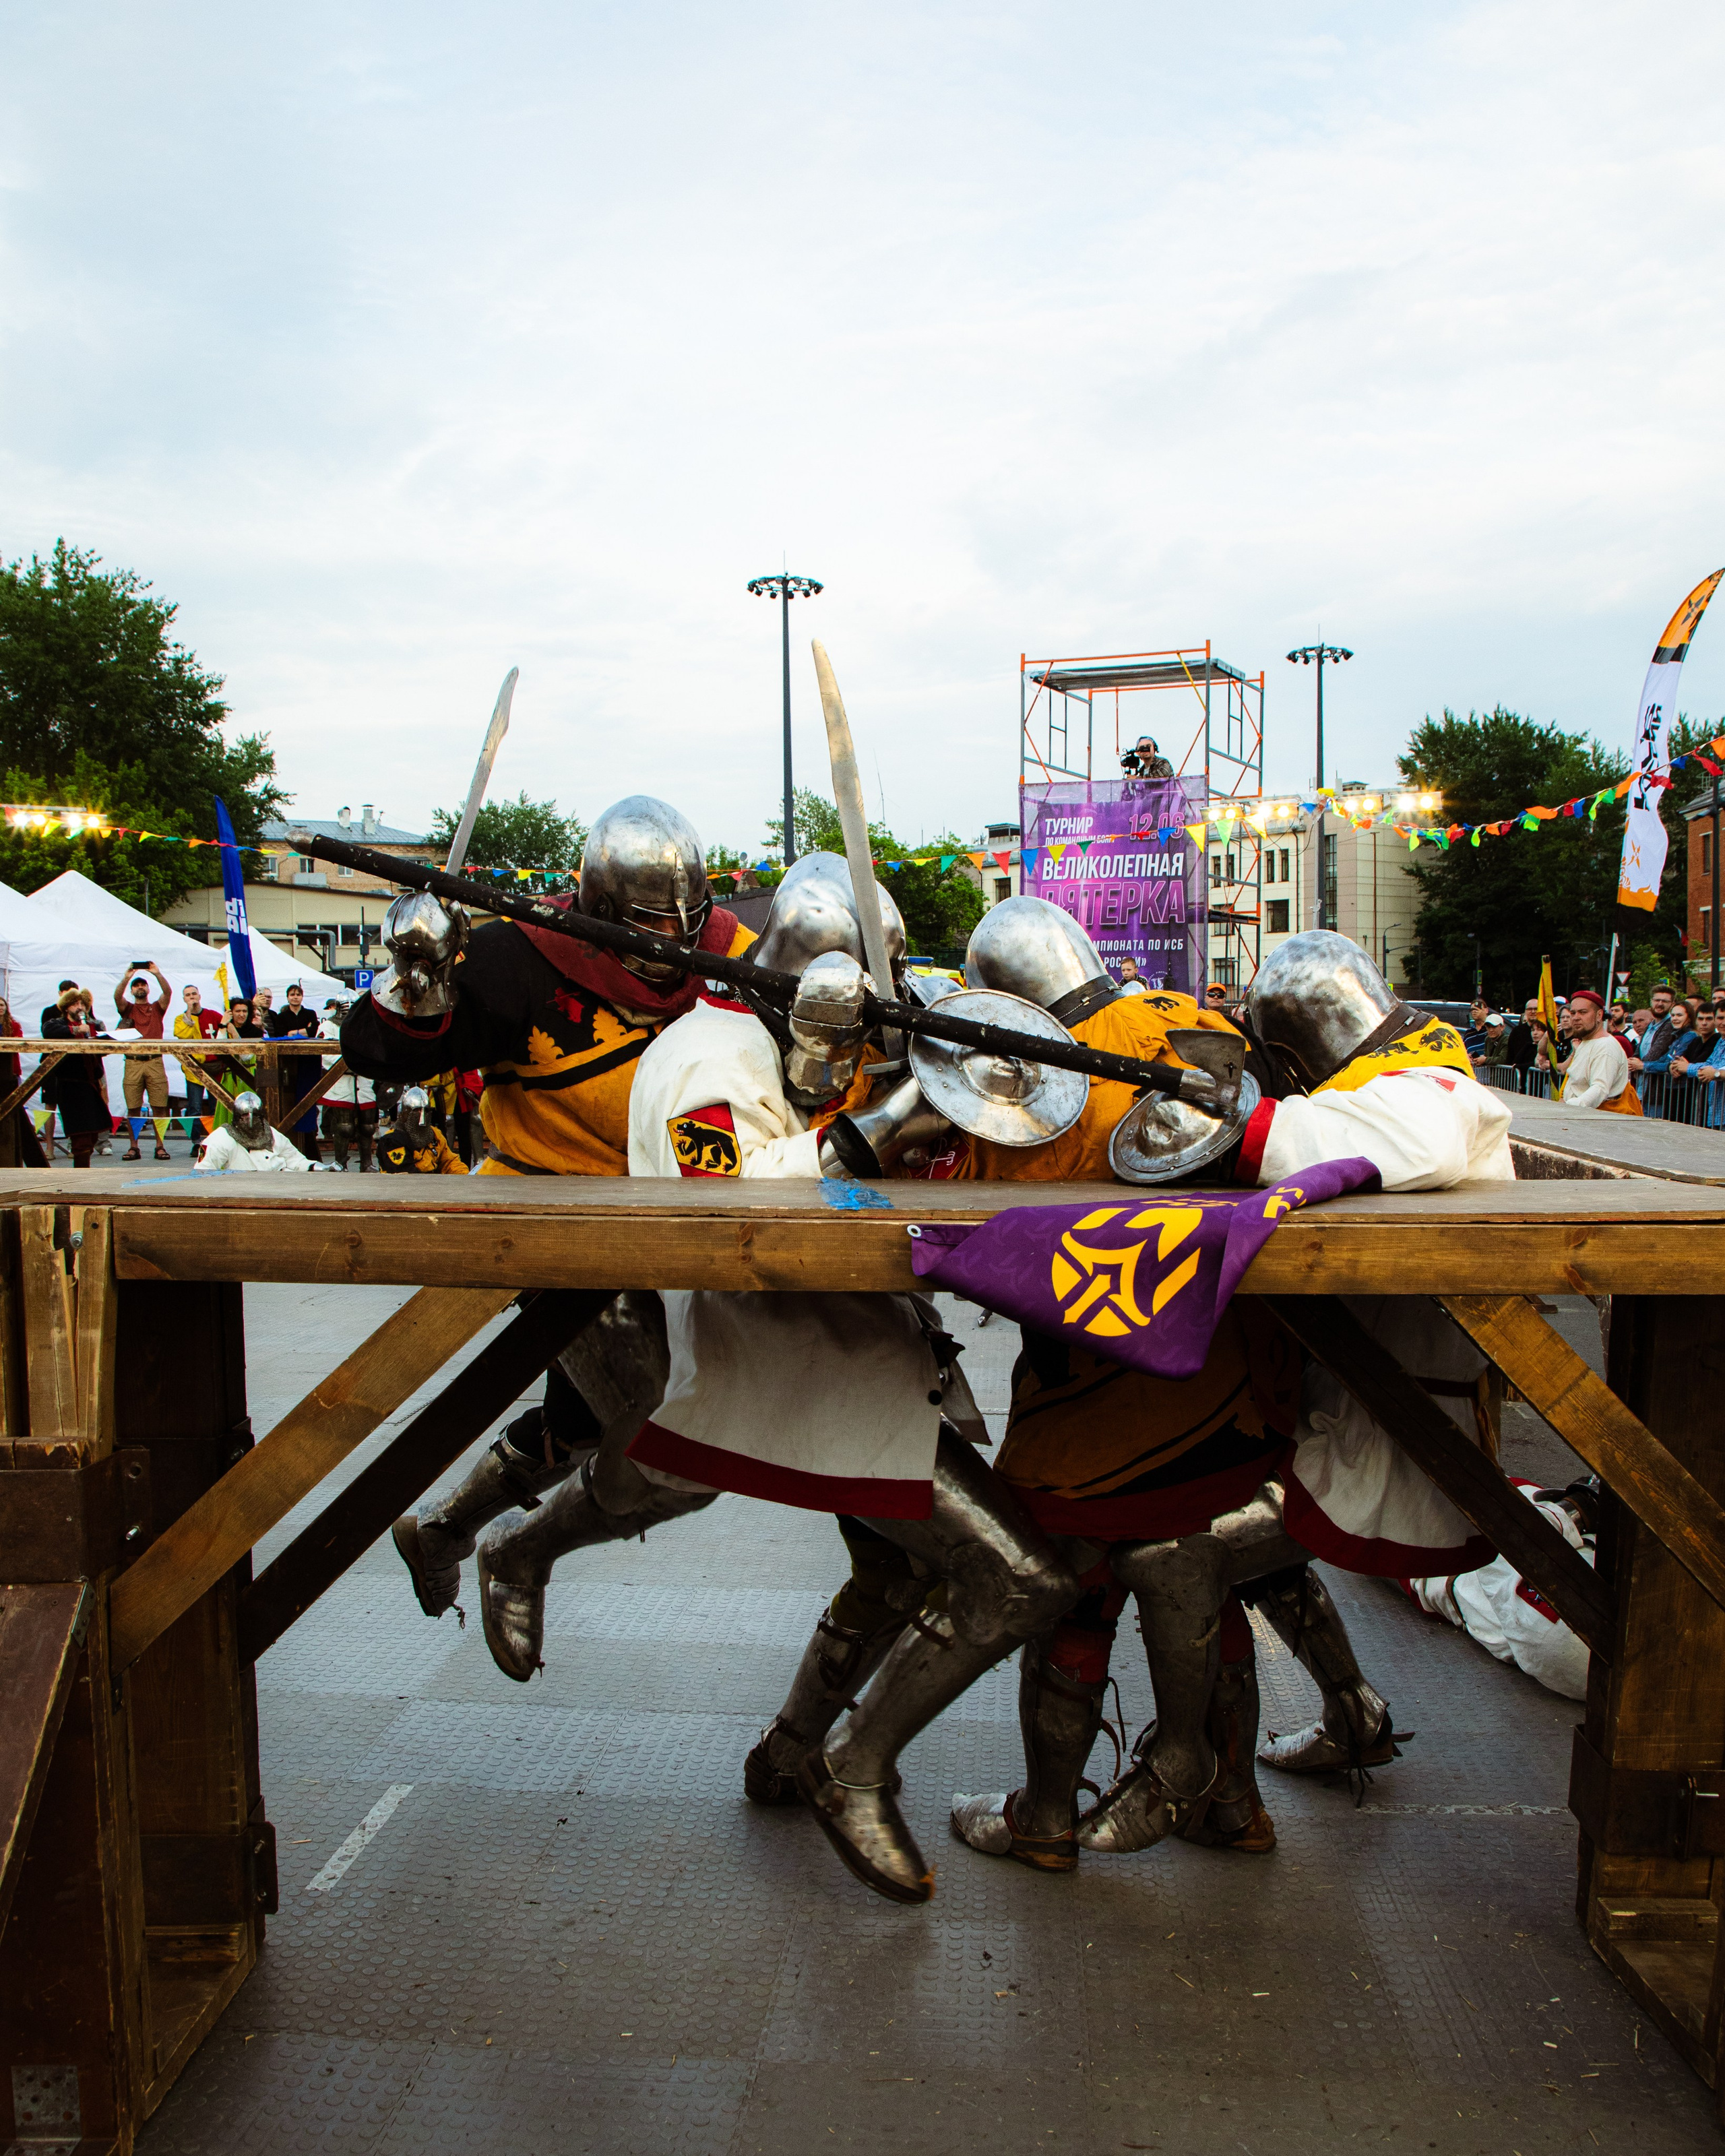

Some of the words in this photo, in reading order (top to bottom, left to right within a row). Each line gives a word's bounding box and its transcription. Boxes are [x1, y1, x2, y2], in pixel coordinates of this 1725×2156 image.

[1045, 817, 1094, 835] ТУРНИР
[1129, 812, 1185, 840] 12.06
[1045, 837, 1054, 846] ПО
[1042, 852, 1185, 881] ВЕЛИКОЛЕПНАЯ
[1092, 939, 1144, 951] МПИОНАТА
[1148, 939, 1160, 951] ПО
[1164, 939, 1184, 950] ИСБ
[1104, 956, 1147, 968] РОСИ»
[359, 972, 369, 986] P
